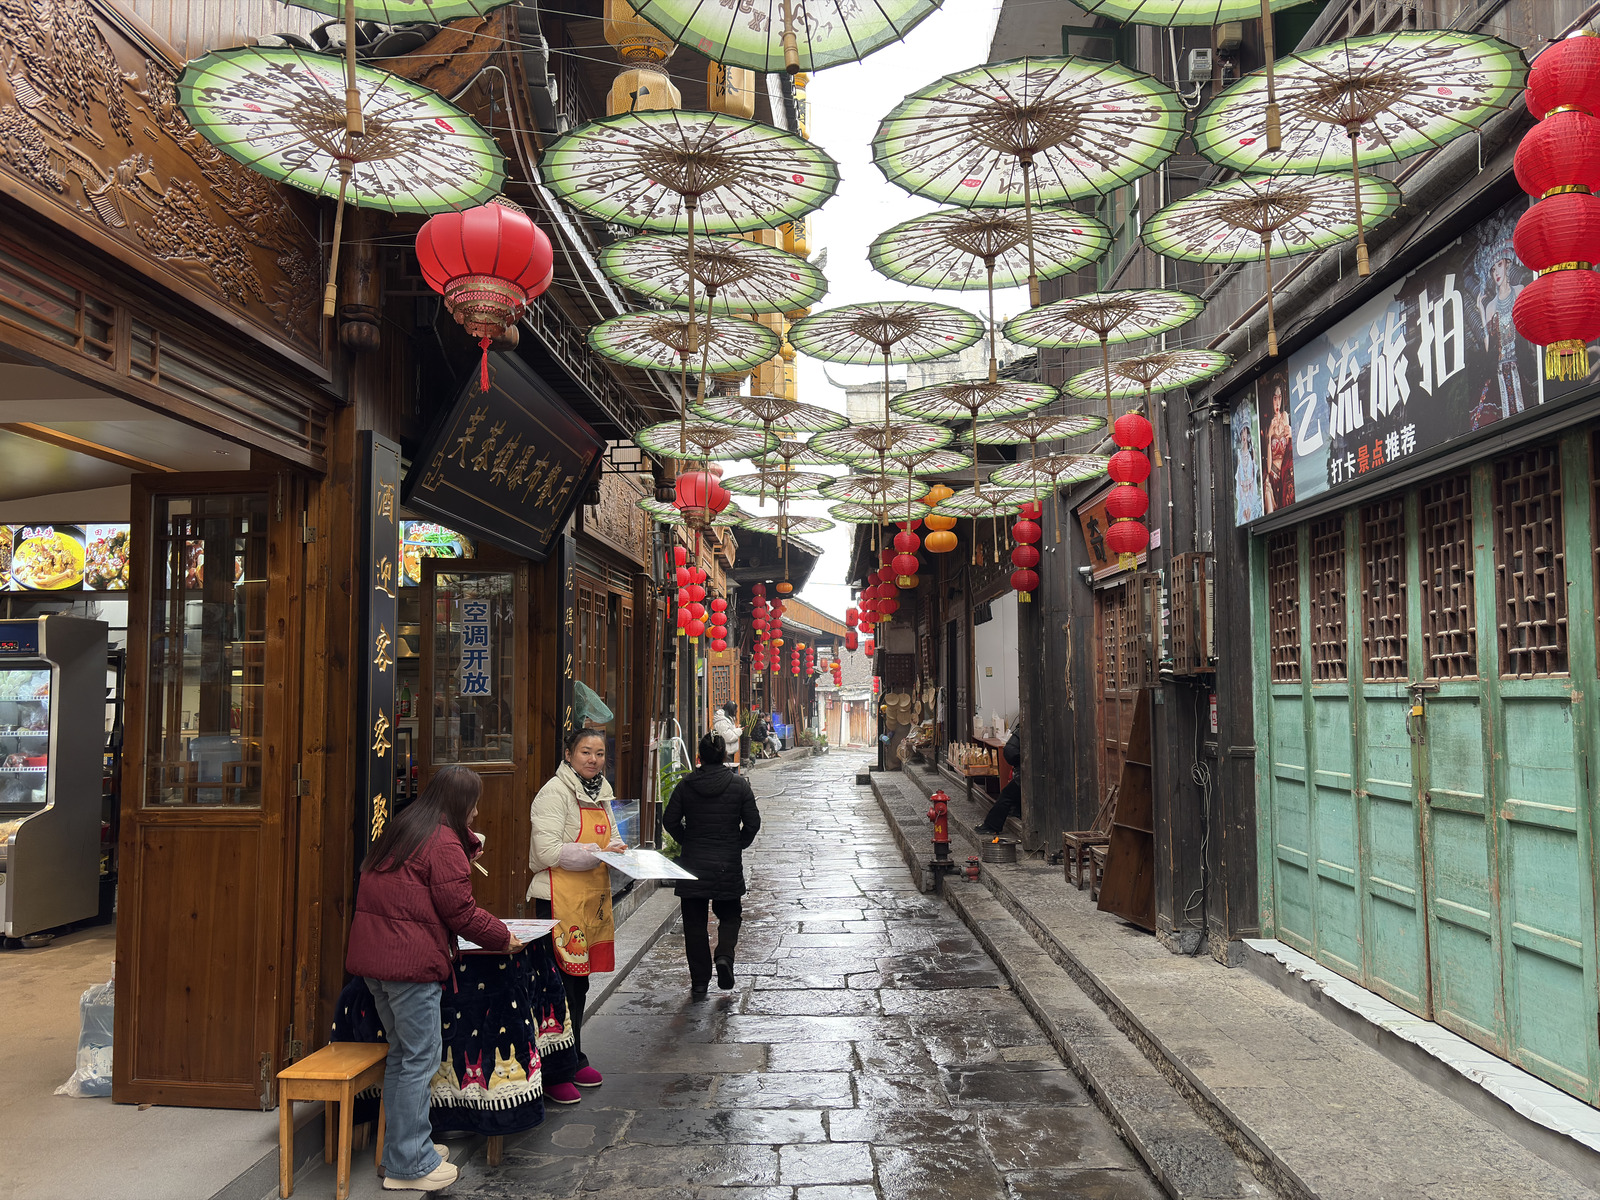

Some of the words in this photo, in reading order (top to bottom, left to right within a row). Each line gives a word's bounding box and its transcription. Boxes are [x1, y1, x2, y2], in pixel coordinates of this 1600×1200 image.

[1291, 273, 1466, 457] 艺流旅拍
[1331, 423, 1417, 485] 打卡景点推荐
[462, 601, 489, 694] 空调开放
